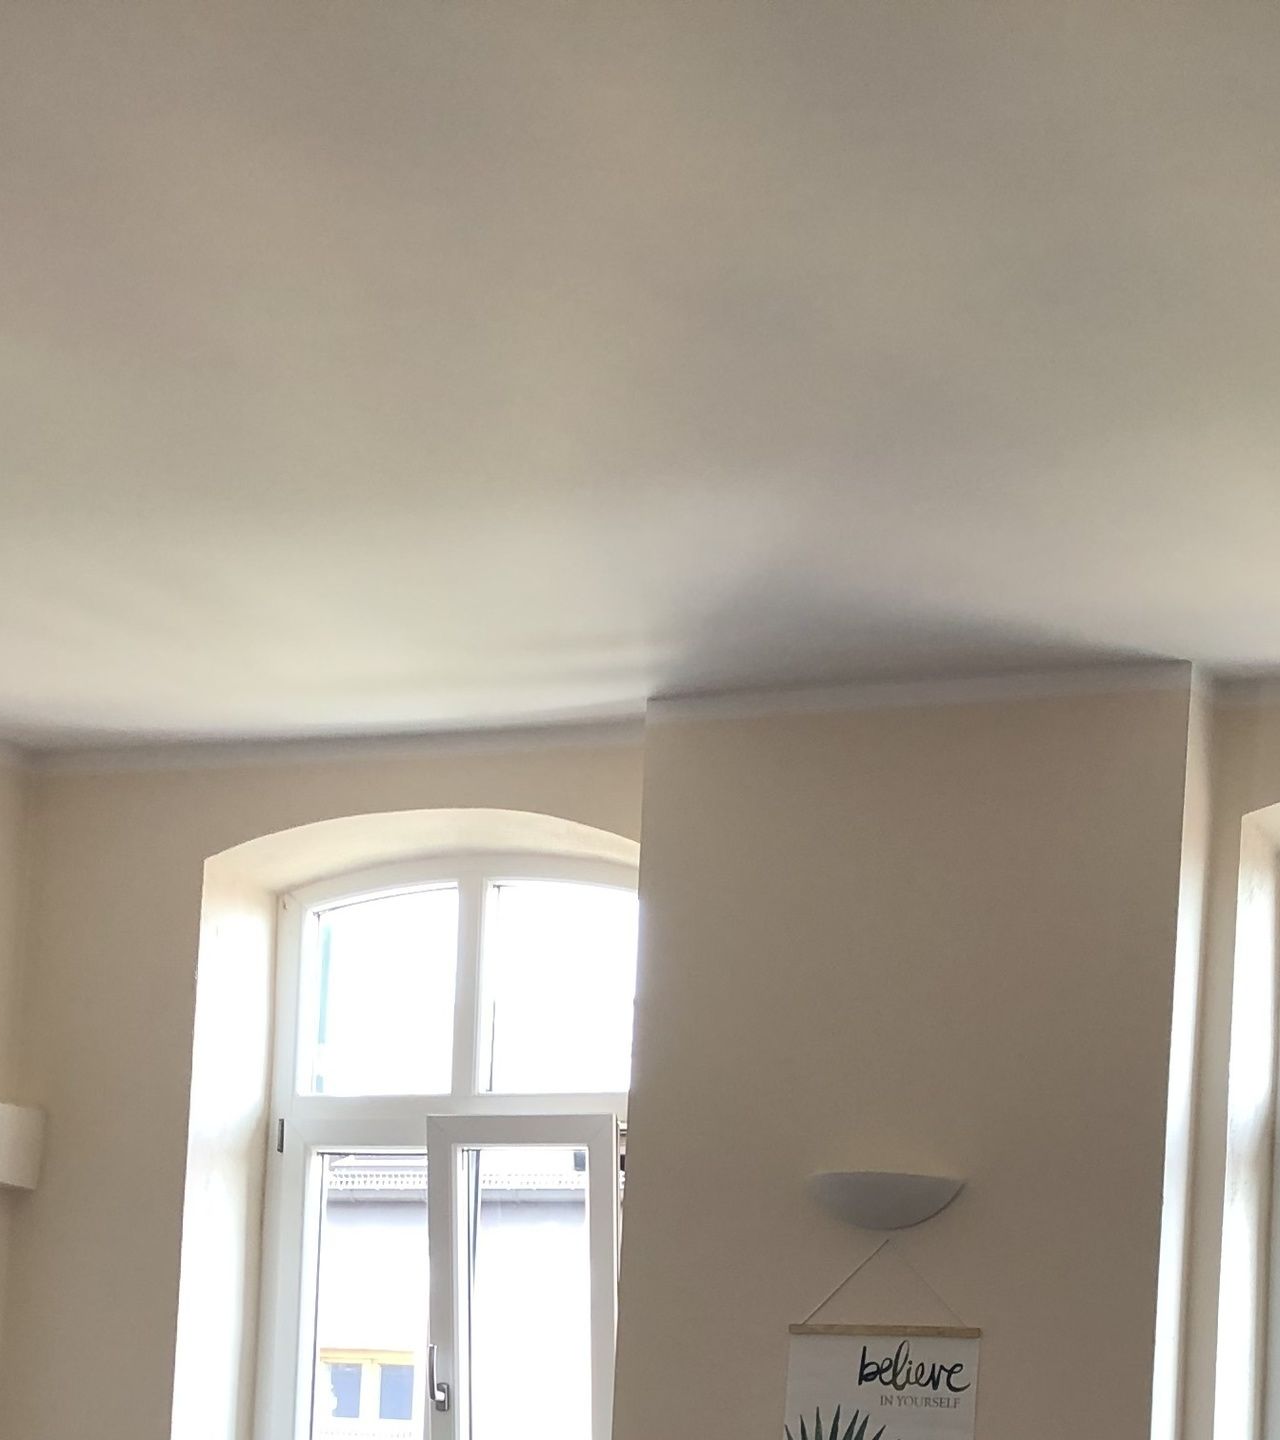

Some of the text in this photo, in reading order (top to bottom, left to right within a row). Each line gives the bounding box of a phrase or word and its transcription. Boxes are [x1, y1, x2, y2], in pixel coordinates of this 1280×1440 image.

[858, 1340, 971, 1392] believe
[880, 1395, 961, 1409] IN YOURSELF
